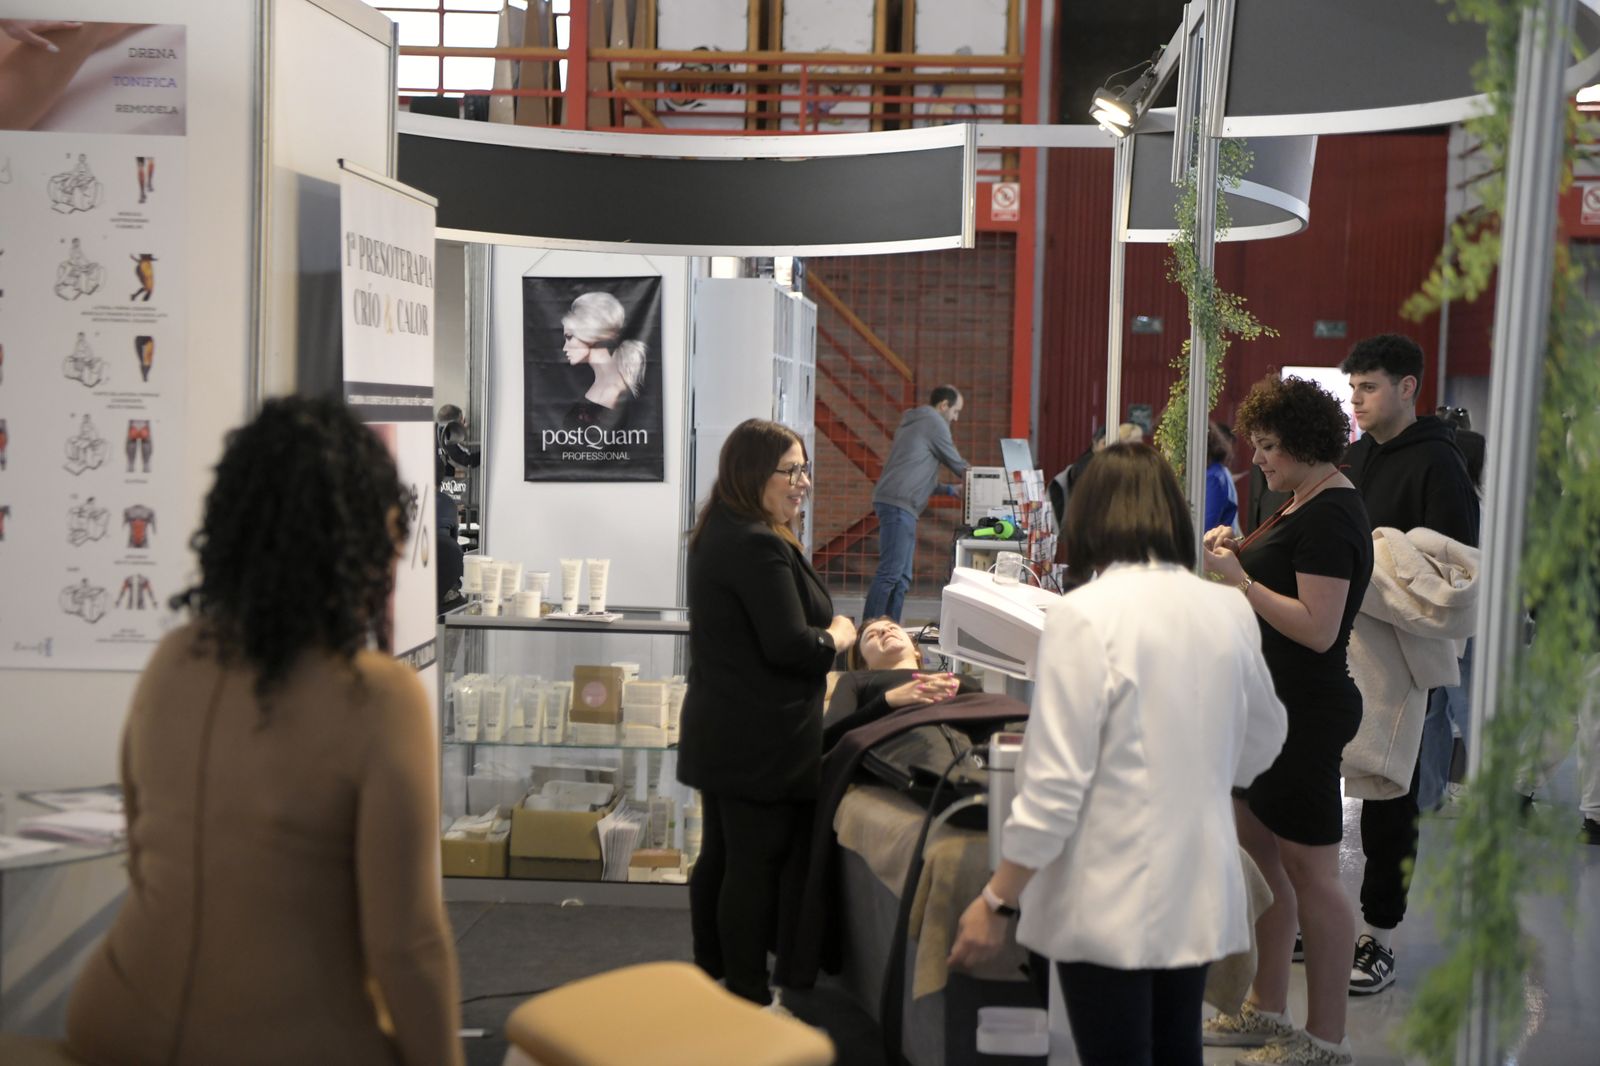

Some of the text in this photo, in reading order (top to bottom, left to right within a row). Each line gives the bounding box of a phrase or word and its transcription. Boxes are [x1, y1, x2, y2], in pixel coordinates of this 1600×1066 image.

[128, 47, 177, 59] DRENA
[112, 75, 178, 88] TONIFICA
[115, 104, 179, 115] REMODELA
[360, 236, 433, 288] PRESOTERAPIA
[397, 298, 429, 336] CALOR
[542, 425, 648, 451] postQuam
[562, 451, 630, 460] PROFESSIONAL
